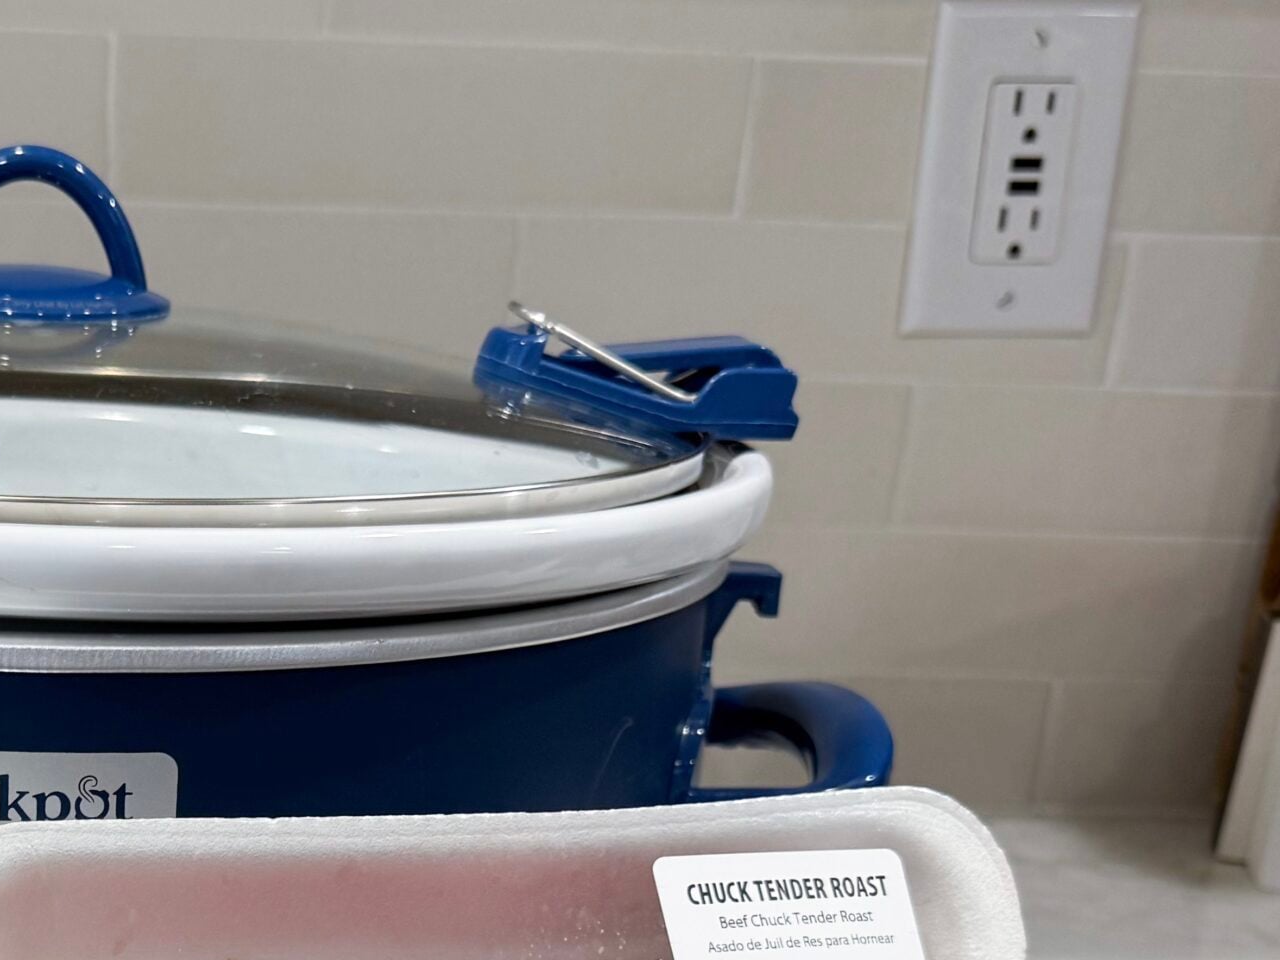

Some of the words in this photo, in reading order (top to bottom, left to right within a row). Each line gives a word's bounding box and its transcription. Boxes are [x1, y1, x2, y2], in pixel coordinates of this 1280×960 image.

[687, 880, 753, 906] CHUCK
[753, 878, 828, 902] TENDER
[830, 875, 888, 899] ROAST
[719, 914, 748, 930] Beef
[751, 911, 792, 928] Chuck
[793, 909, 838, 925] Tender
[839, 909, 874, 923] Roast
[708, 939, 744, 954] Asado
[747, 938, 762, 950] de
[764, 936, 784, 950] Juil
[786, 935, 801, 948] de
[803, 935, 823, 948] Res
[825, 936, 850, 950] para
[852, 933, 895, 946] Hornear
